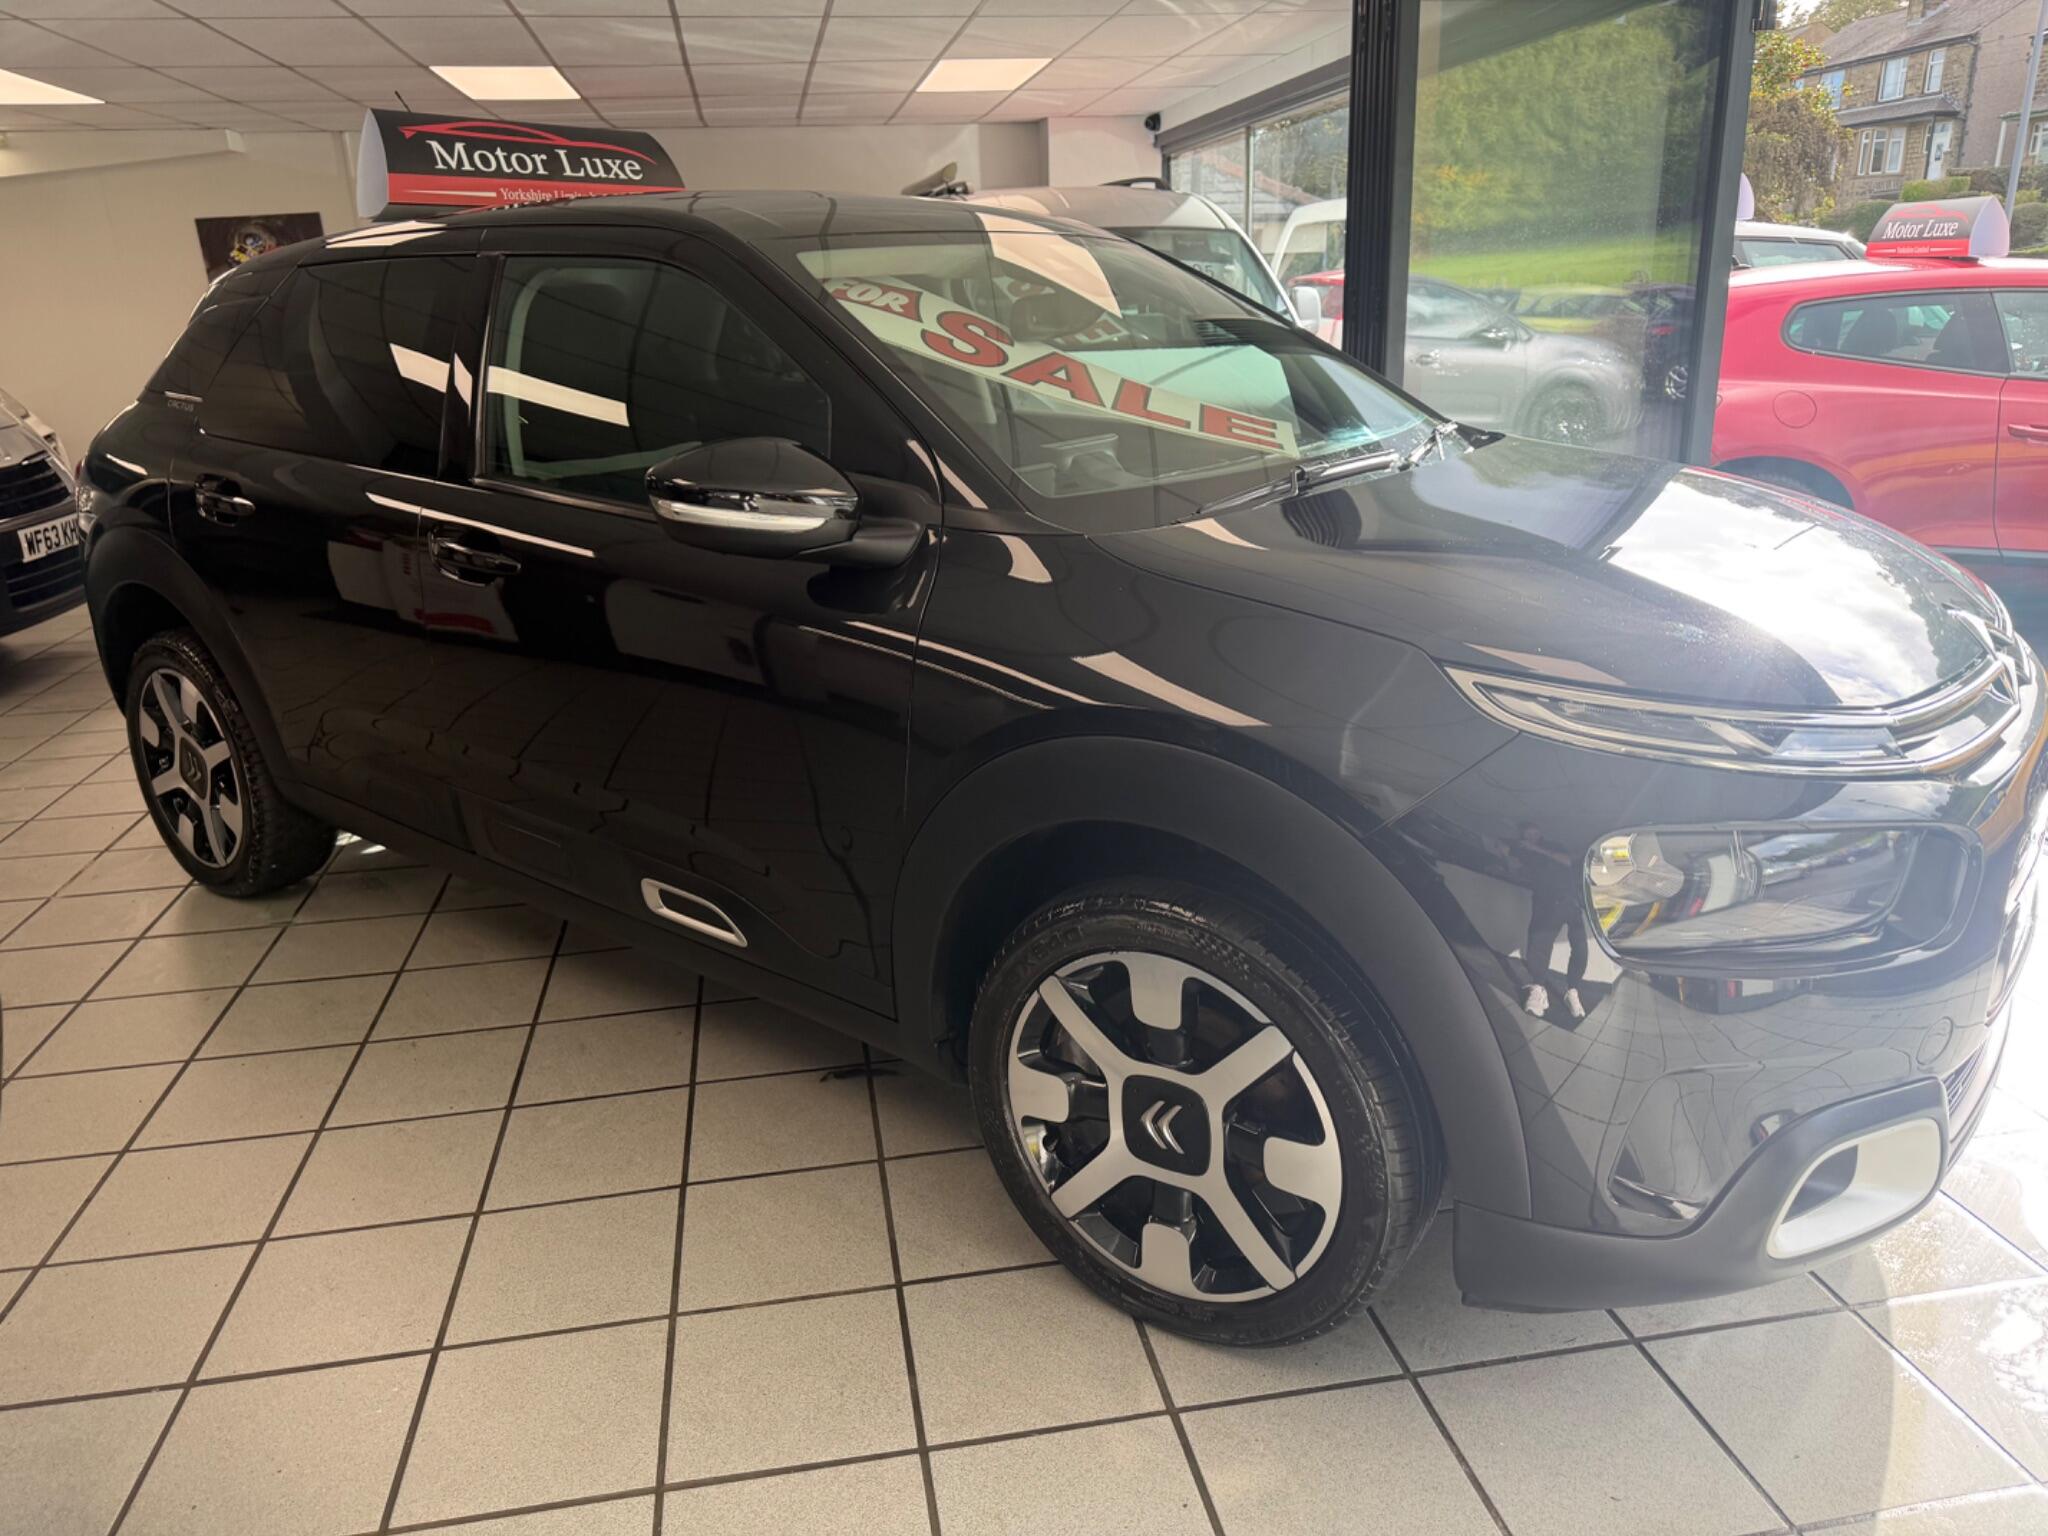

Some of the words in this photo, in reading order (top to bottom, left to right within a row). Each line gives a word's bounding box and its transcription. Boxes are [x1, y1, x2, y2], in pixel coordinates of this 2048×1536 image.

[425, 140, 547, 176] Motor
[554, 149, 644, 181] Luxe
[500, 187, 552, 202] Yorkshire
[1882, 221, 1923, 239] Motor
[1923, 219, 1959, 237] Luxe
[823, 280, 904, 312] FOR
[921, 311, 1286, 450] SALE
[24, 525, 60, 556] WF63
